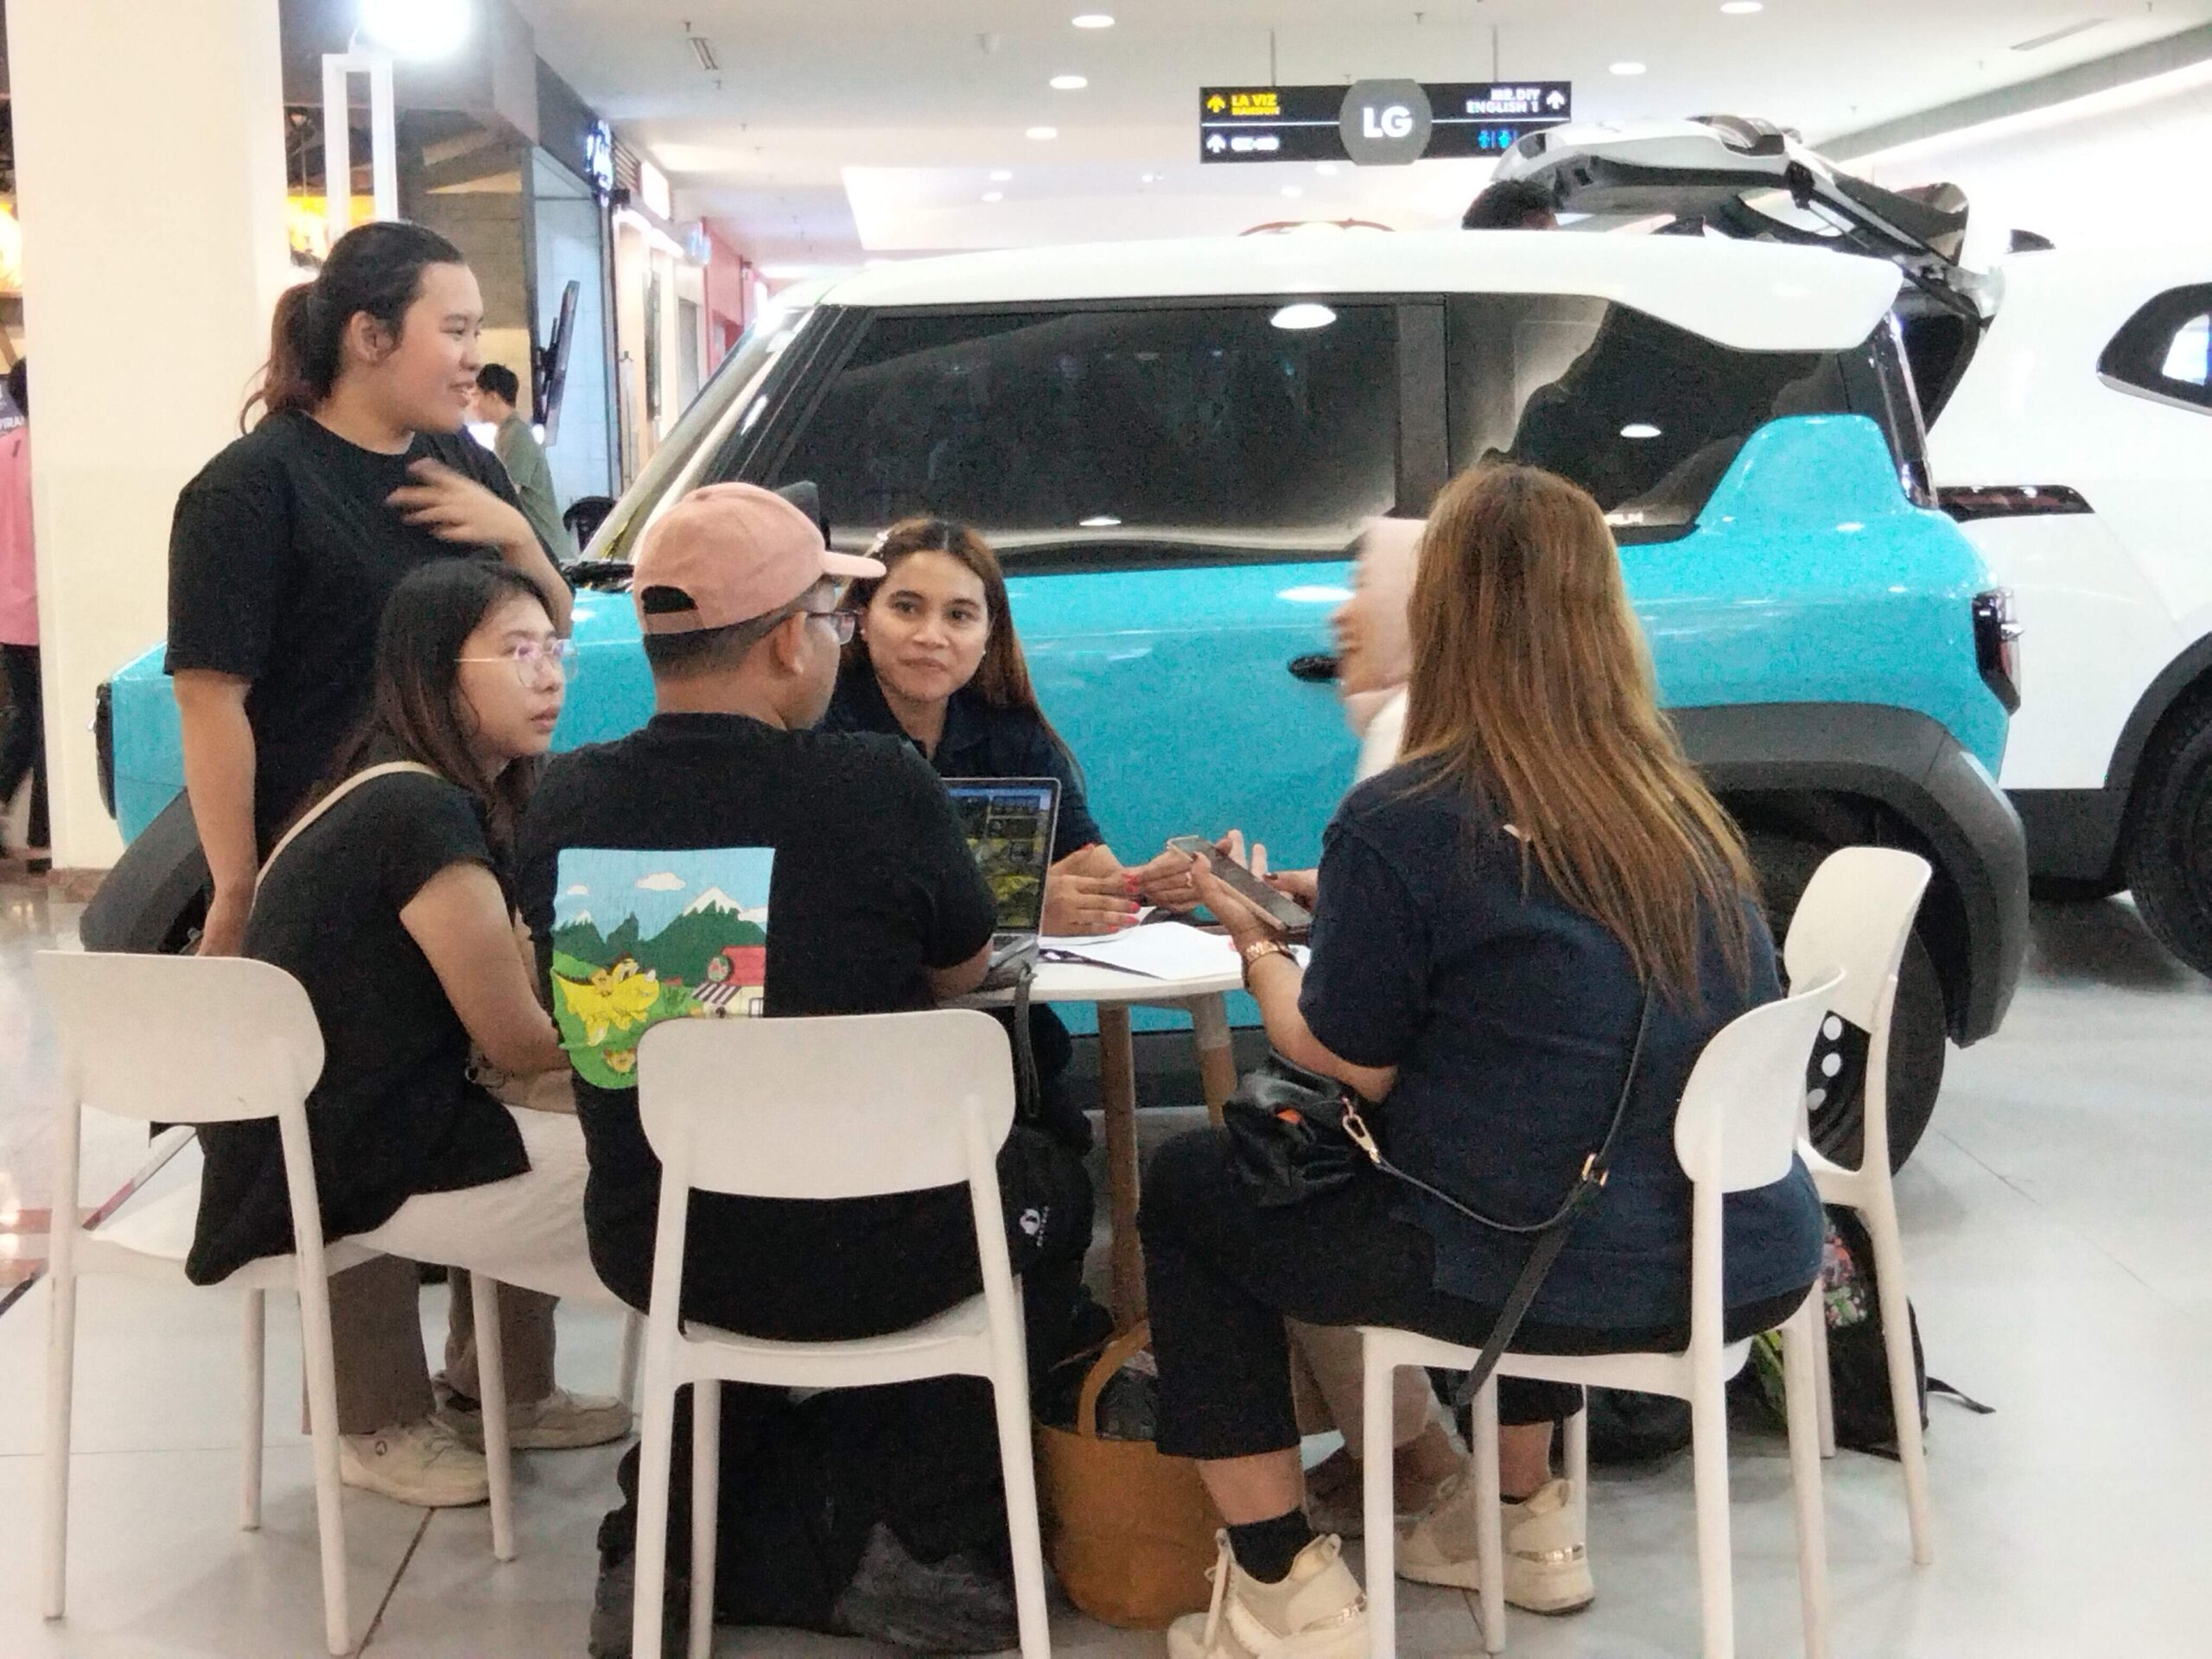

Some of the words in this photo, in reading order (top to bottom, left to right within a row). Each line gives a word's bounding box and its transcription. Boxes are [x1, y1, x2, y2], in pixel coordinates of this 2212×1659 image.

[1231, 94, 1250, 106] LA
[1252, 92, 1277, 106] VIZ
[1465, 100, 1527, 114] ENGLISH
[1363, 105, 1412, 138] LG
